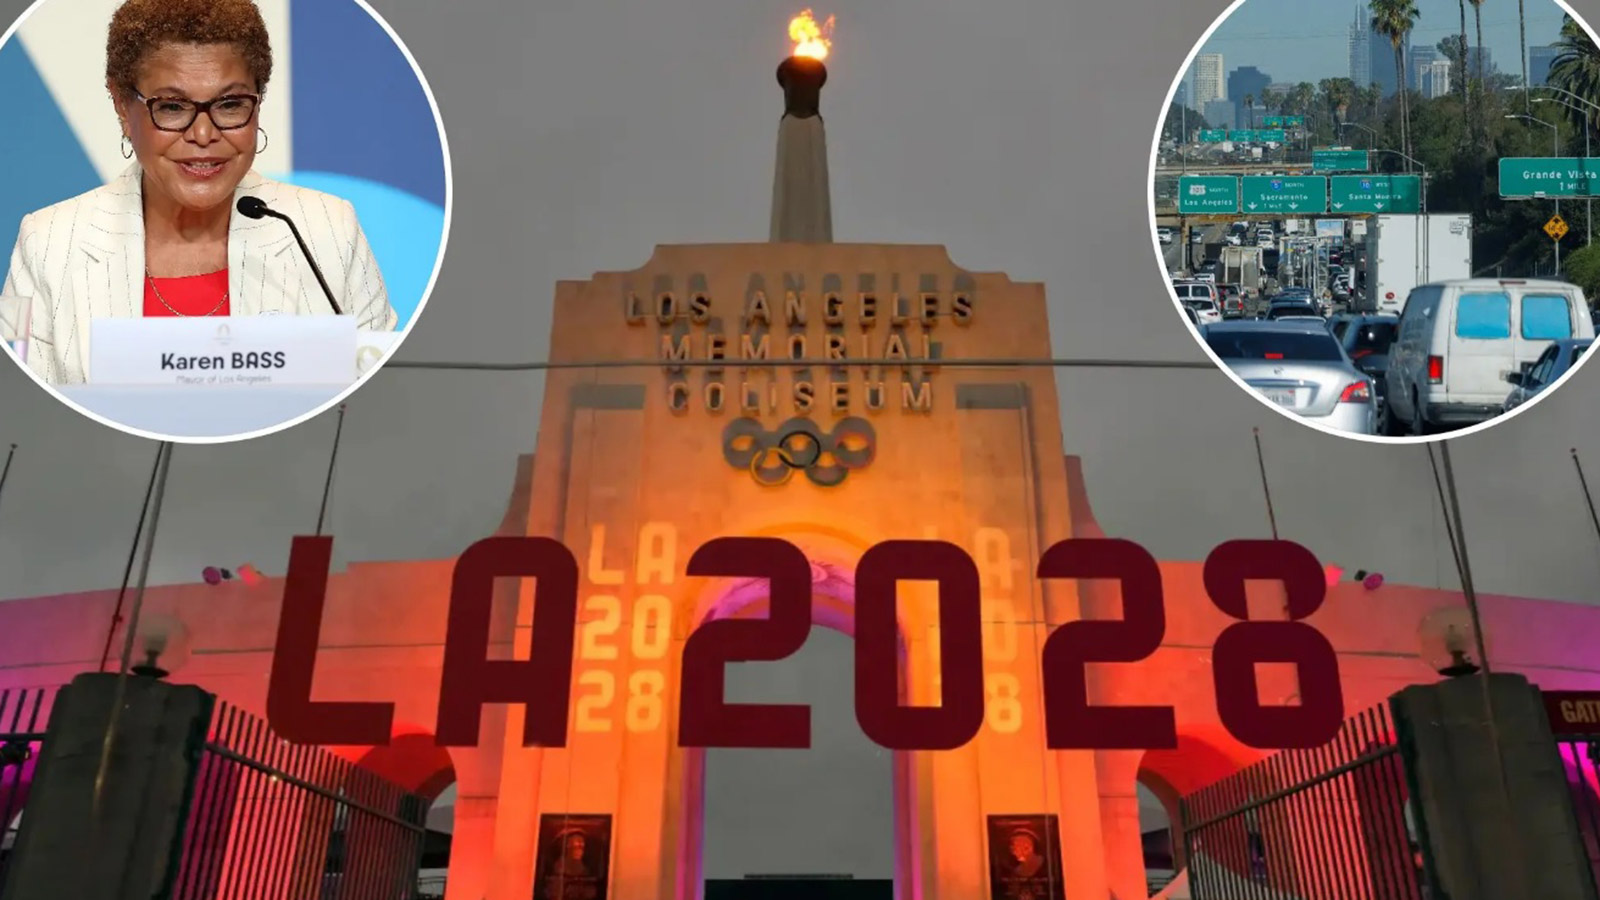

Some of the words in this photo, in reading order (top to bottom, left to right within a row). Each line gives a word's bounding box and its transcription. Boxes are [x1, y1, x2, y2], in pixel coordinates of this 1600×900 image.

[1522, 170, 1562, 179] Grande
[1567, 170, 1597, 179] Vista
[1560, 182, 1564, 191] 1
[1202, 199, 1233, 207] Angeles
[626, 290, 711, 325] LOS
[750, 290, 973, 326] ANGELES
[161, 353, 224, 370] Karen
[231, 351, 286, 369] BASS
[661, 333, 939, 372] MEMORIAL
[176, 375, 205, 384] Mayor
[207, 375, 217, 383] of
[219, 375, 234, 383] Los
[236, 374, 272, 385] Angeles
[668, 382, 932, 413] COLISEUM
[588, 521, 677, 584] LA
[266, 535, 579, 748] LA
[677, 536, 1345, 751] 2028
[581, 594, 672, 661] 20
[574, 669, 665, 732] 28
[1561, 700, 1600, 724] GAT
